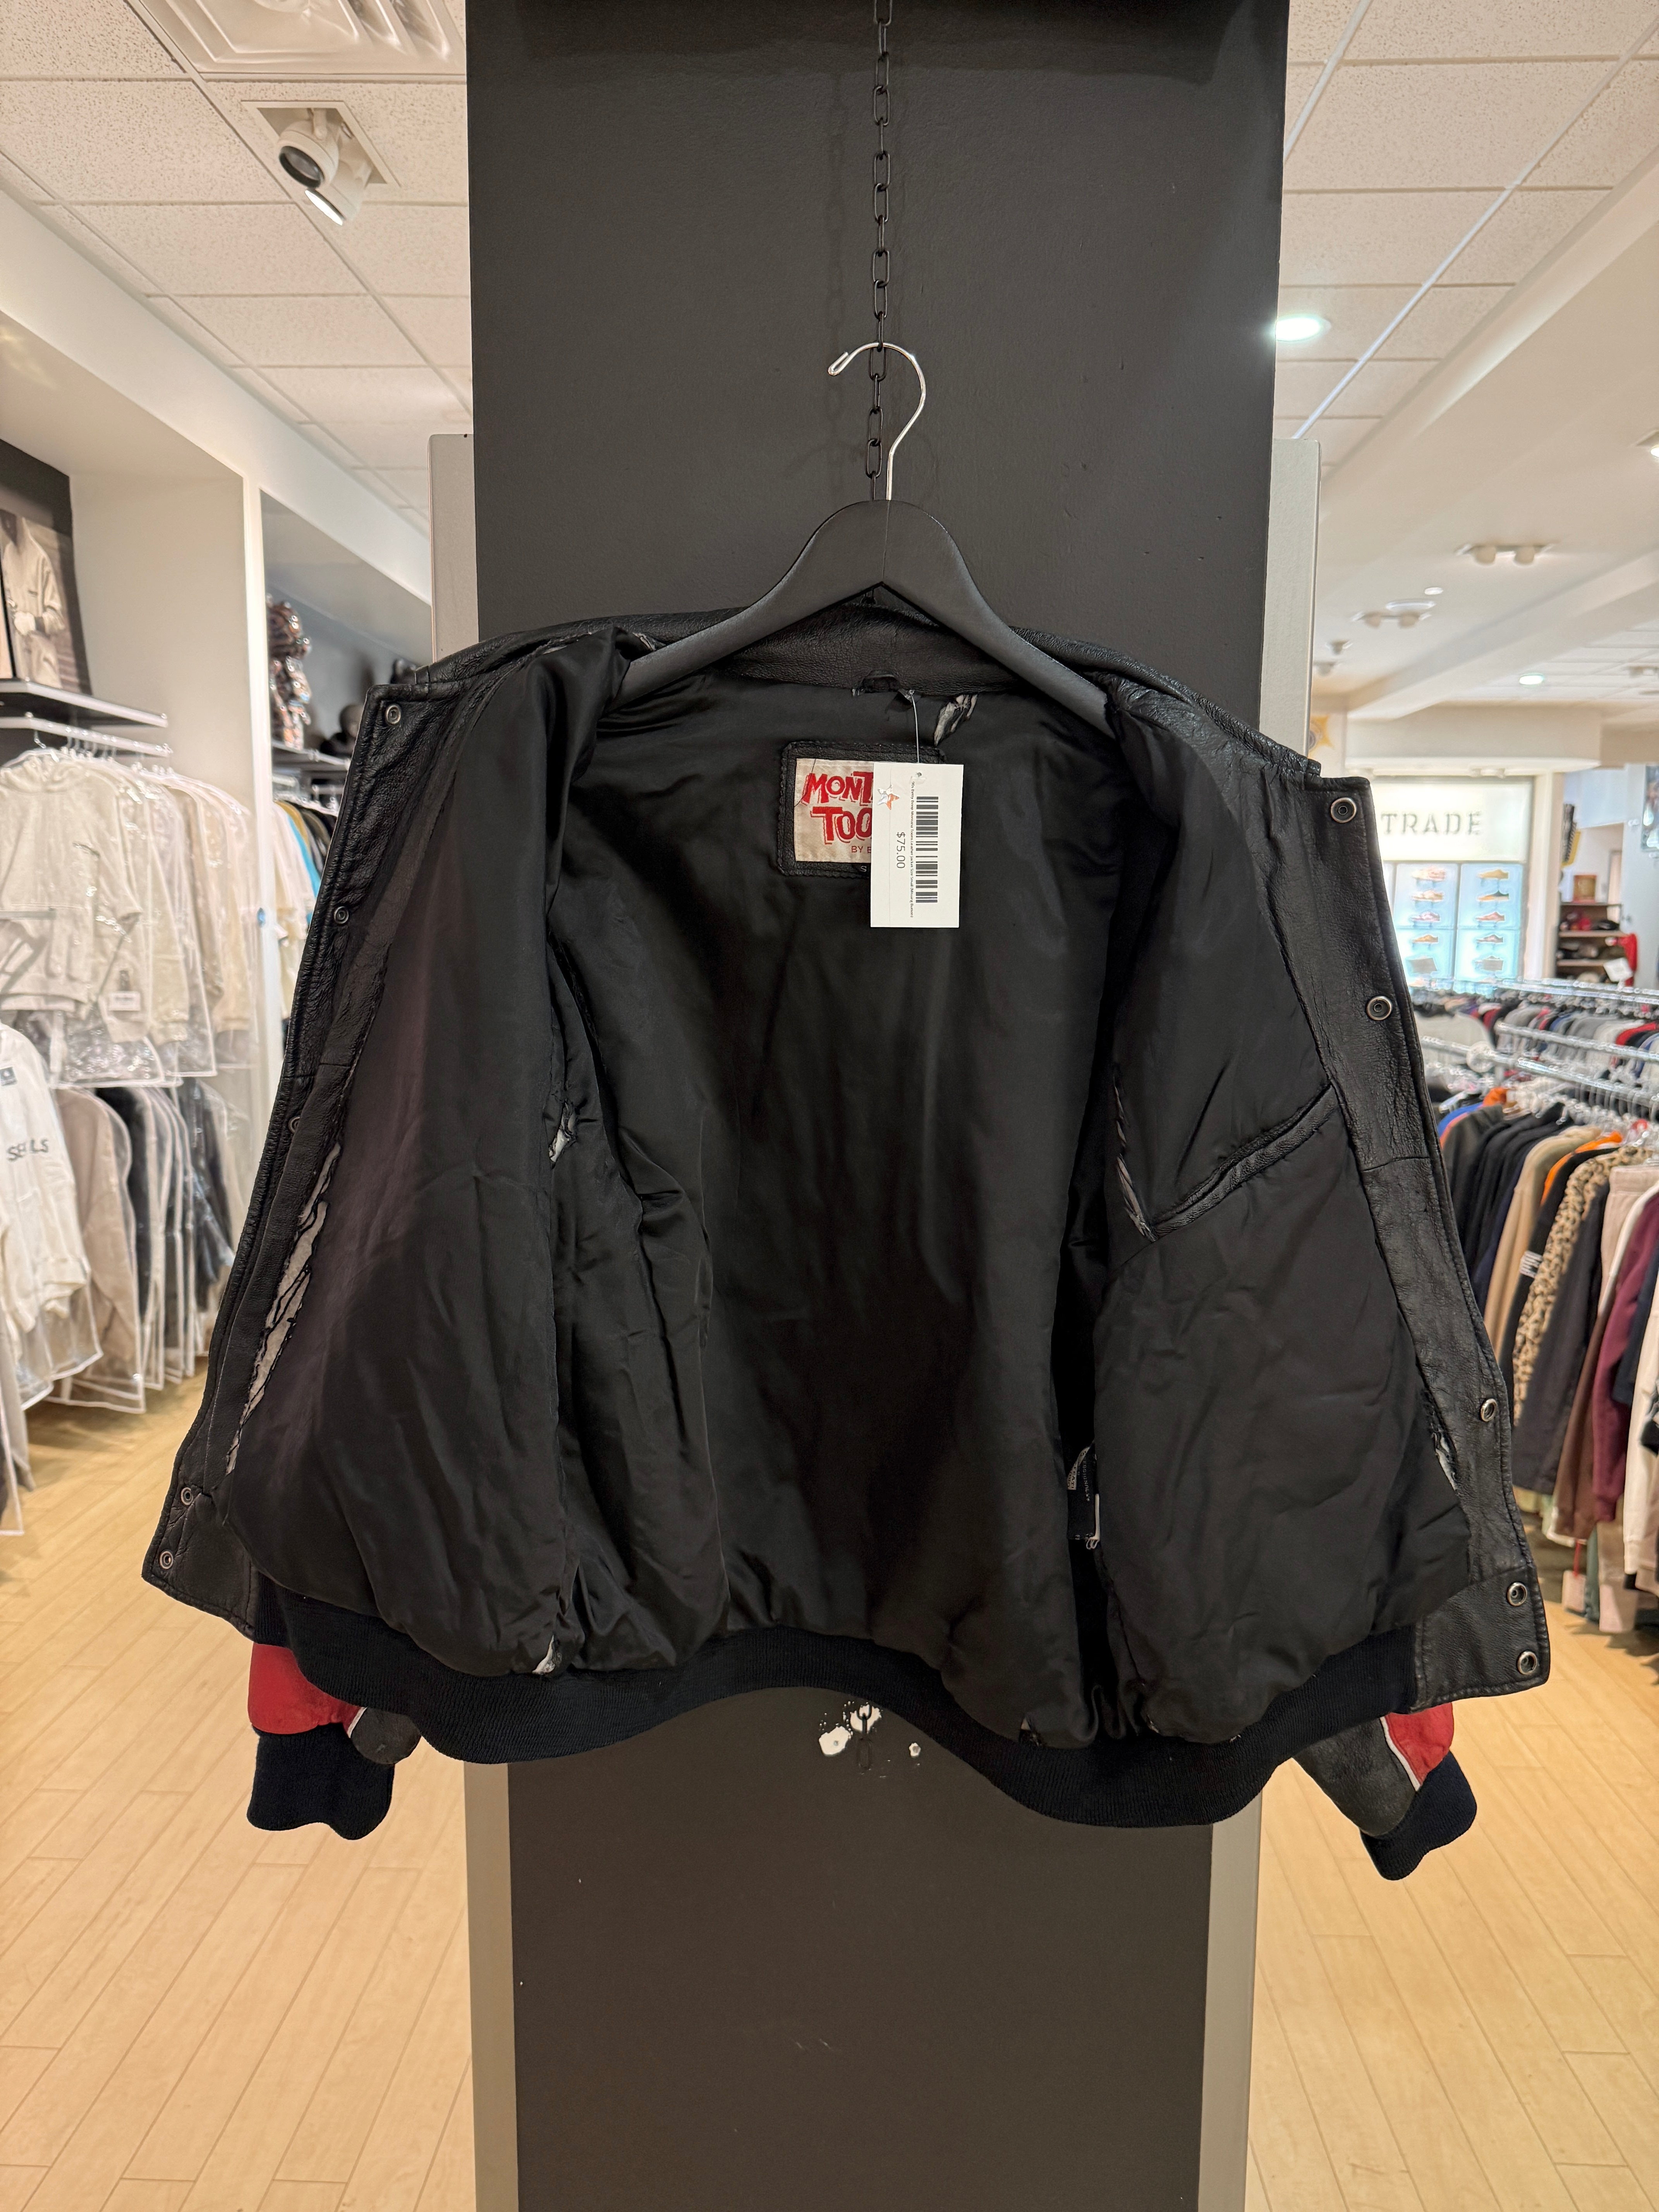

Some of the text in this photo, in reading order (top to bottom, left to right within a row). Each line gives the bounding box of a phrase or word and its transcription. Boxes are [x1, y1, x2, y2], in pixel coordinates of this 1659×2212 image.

[801, 771, 874, 806] MONT
[810, 807, 872, 845] TOO
[1380, 811, 1481, 835] TRADE
[896, 832, 906, 869] $75.00
